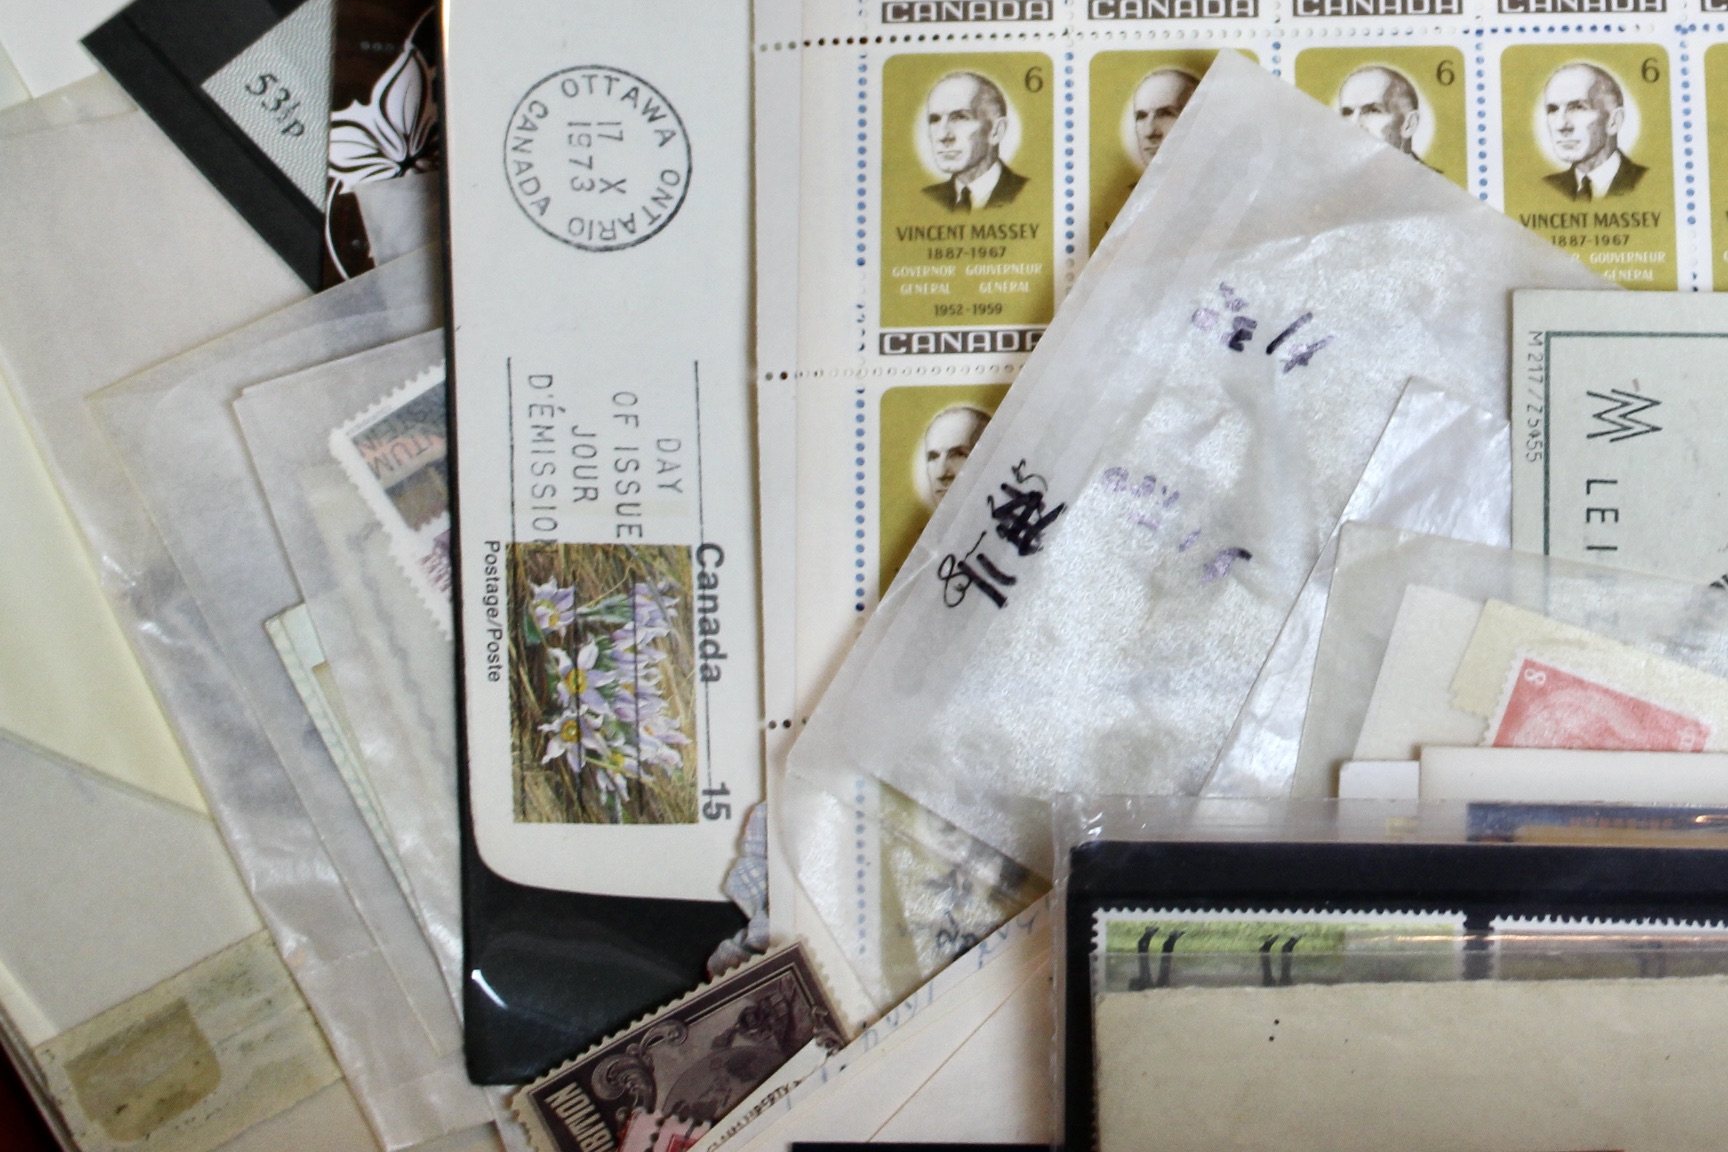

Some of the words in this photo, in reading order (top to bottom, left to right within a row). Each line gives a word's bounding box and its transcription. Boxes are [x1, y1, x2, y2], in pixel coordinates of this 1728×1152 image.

[886, 0, 1050, 23] CANADA
[1024, 65, 1043, 92] 6
[1436, 60, 1456, 86] 6
[1640, 56, 1660, 83] 6
[560, 73, 677, 148] OTTAWA
[596, 120, 625, 143] 17
[511, 99, 552, 217] CANADA
[598, 176, 627, 195] X
[567, 168, 682, 241] ONTARIO
[1518, 211, 1586, 229] VINCENT
[1592, 210, 1660, 228] MASSEY
[896, 224, 965, 242] VINCENT
[971, 222, 1039, 241] MASSEY
[927, 246, 1006, 260] 1887-1967
[611, 390, 640, 429] OF
[570, 424, 600, 504] JOUR
[655, 437, 683, 494] DAY
[613, 446, 643, 540] ISSUE
[482, 539, 503, 684] Postage/Poste
[695, 541, 728, 684] Canada
[1523, 667, 1547, 686] 8
[701, 780, 732, 822] 15
